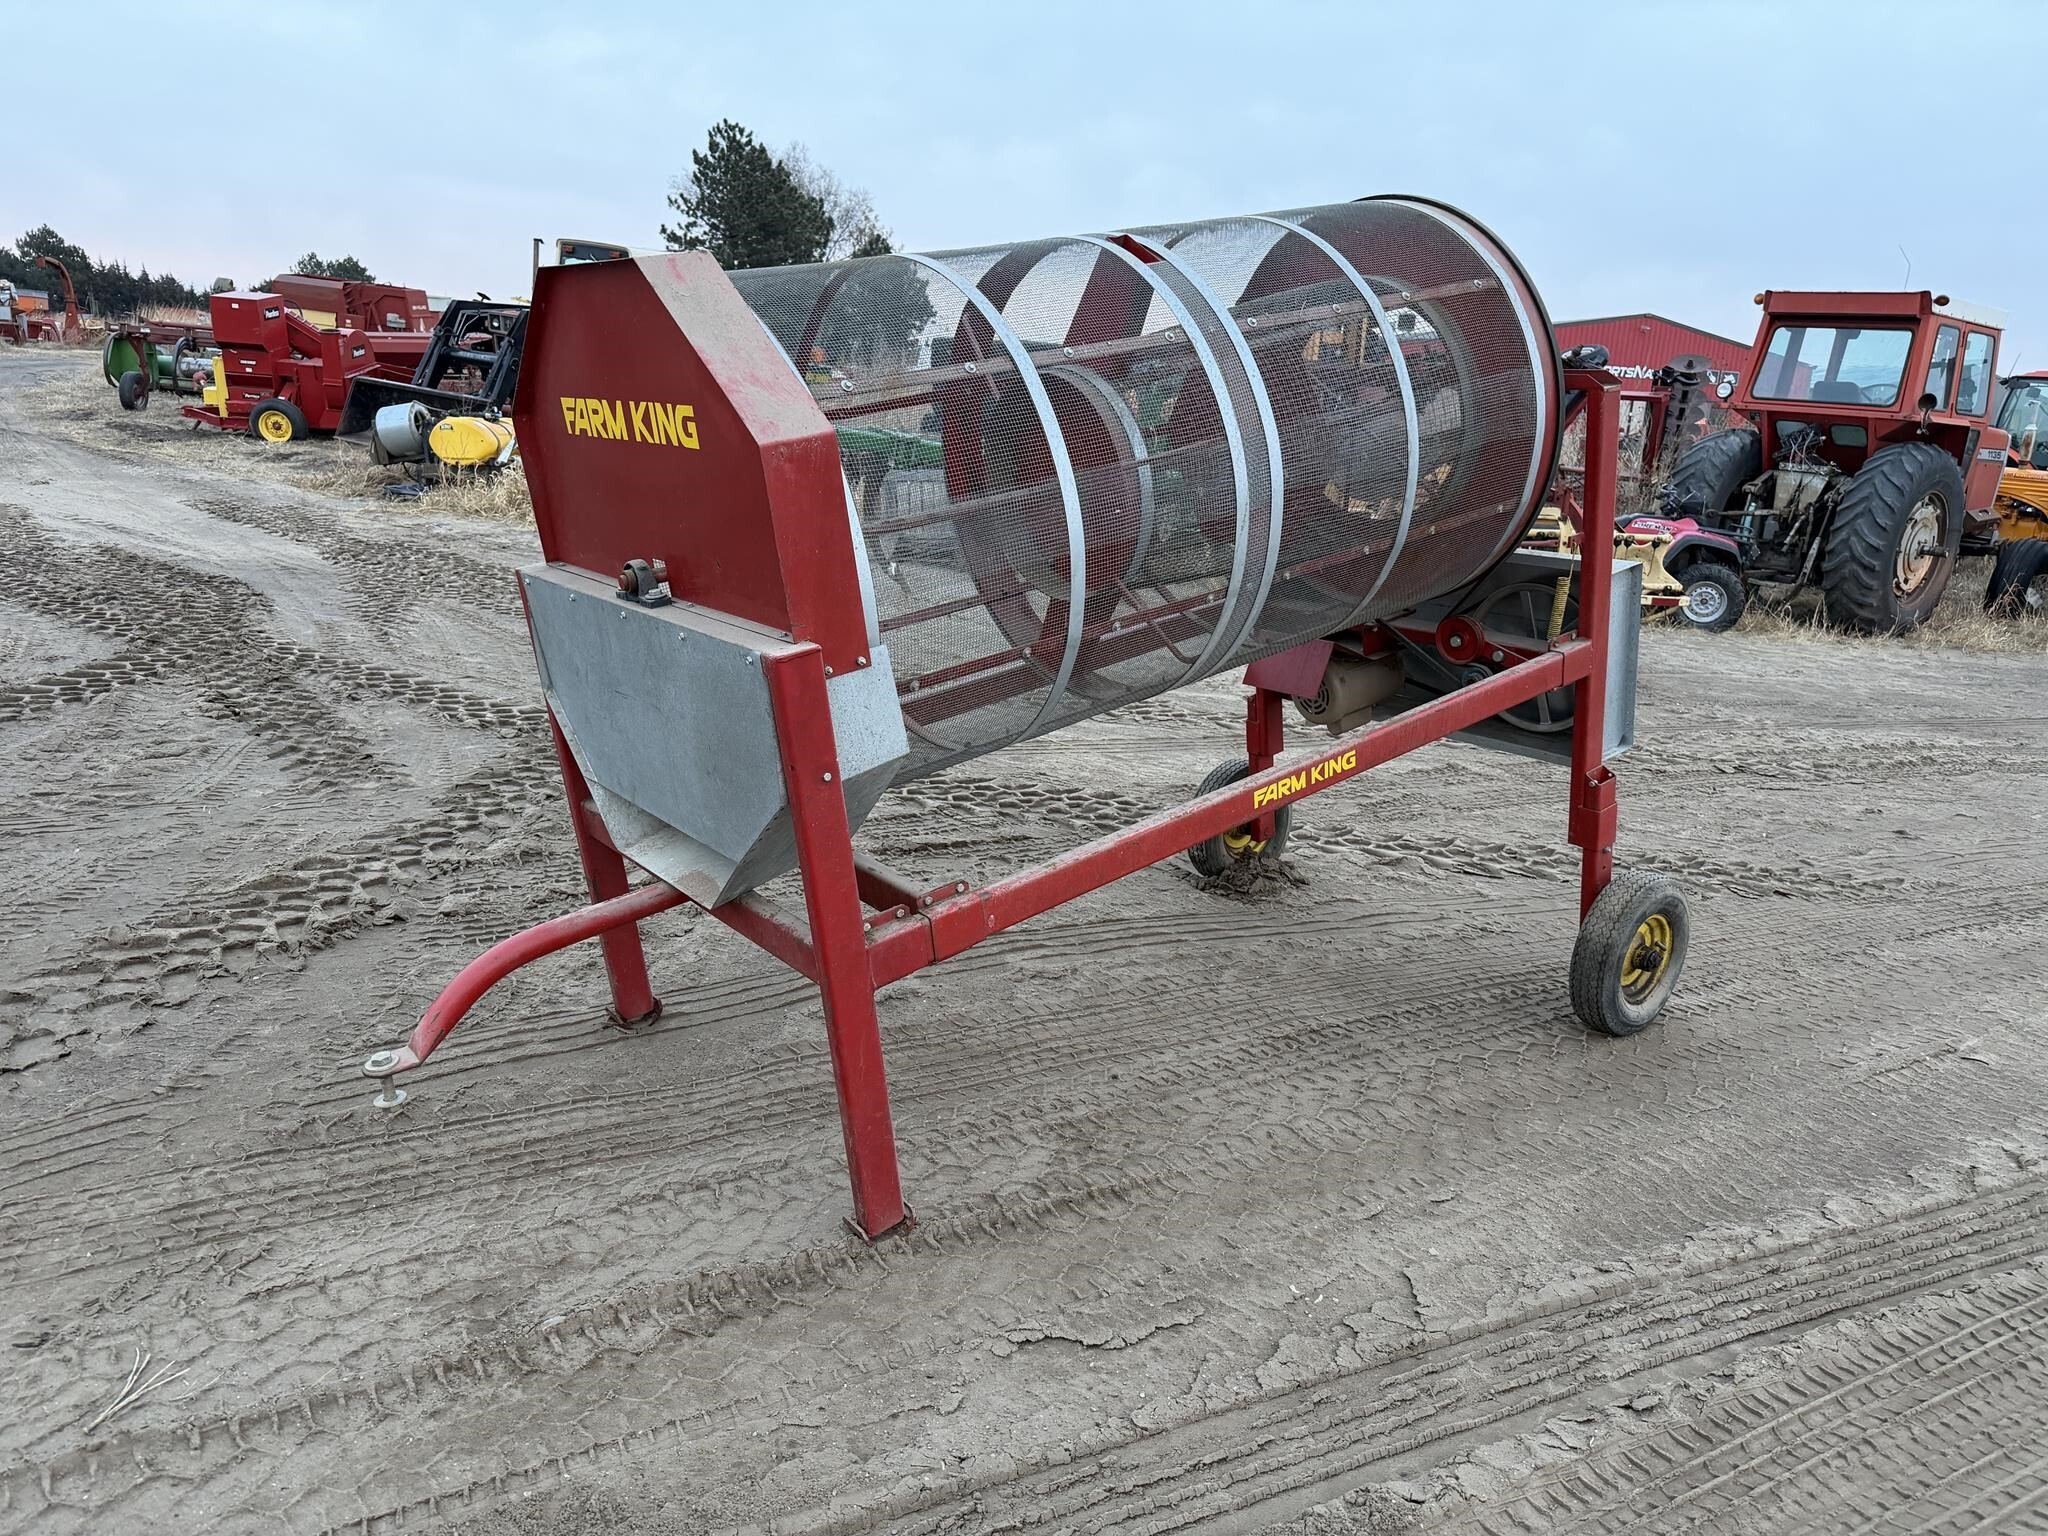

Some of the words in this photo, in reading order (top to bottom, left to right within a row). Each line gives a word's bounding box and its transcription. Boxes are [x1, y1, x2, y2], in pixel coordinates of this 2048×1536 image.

[560, 397, 629, 441] FARM
[629, 400, 700, 450] KING
[1253, 771, 1307, 809] FARM
[1311, 749, 1357, 784] KING
